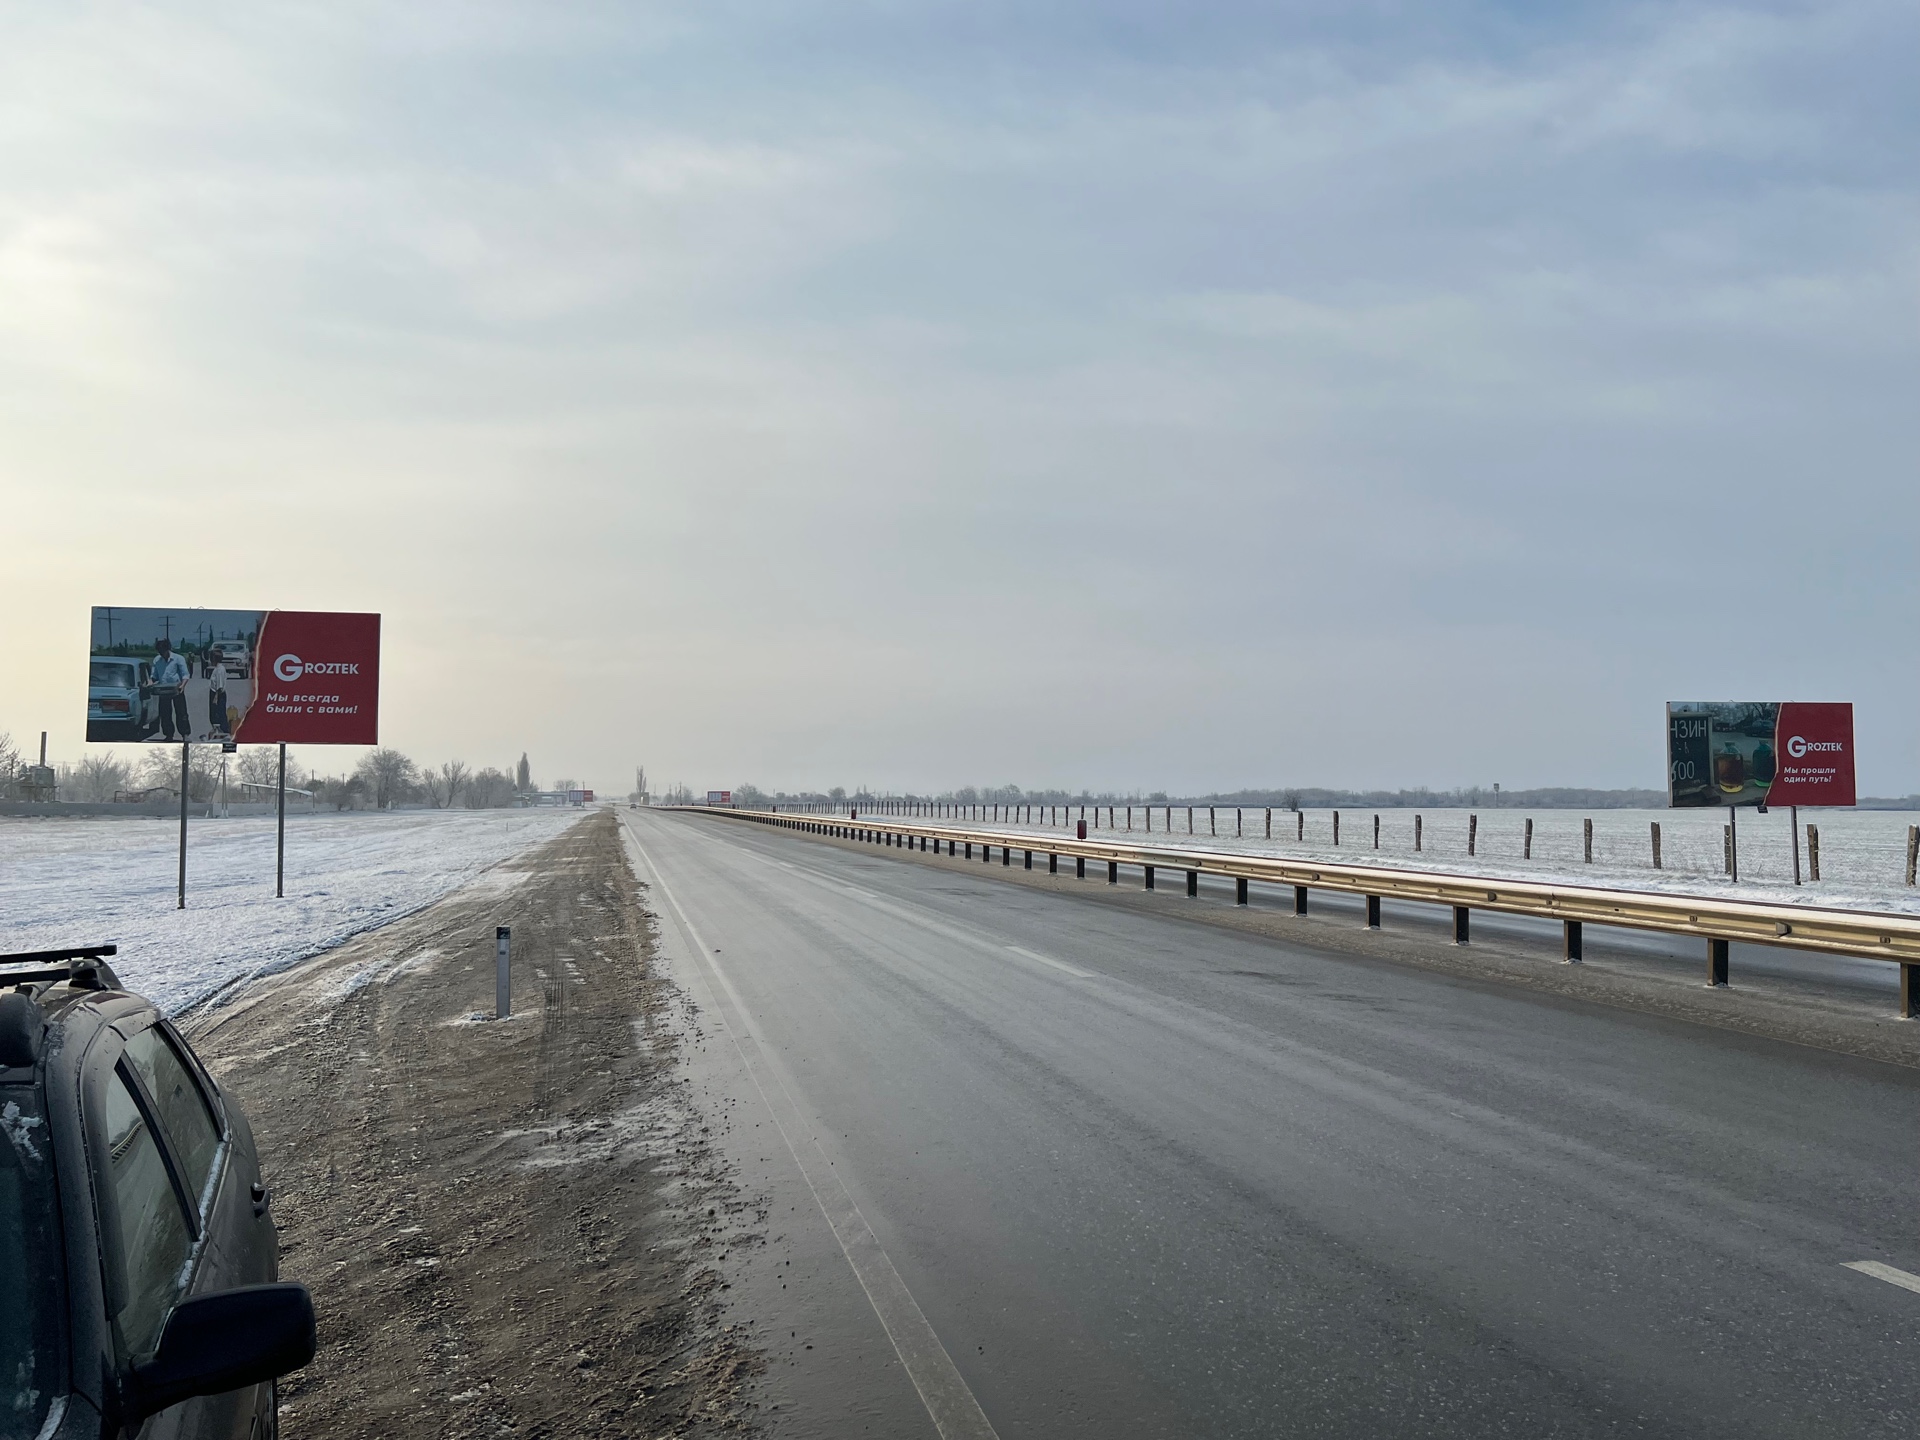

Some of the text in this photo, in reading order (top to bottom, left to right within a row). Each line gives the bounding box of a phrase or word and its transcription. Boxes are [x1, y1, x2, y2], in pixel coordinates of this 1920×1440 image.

[273, 653, 359, 681] GROZTEK
[266, 693, 339, 703] Мы всегда
[266, 704, 302, 713] были
[318, 705, 358, 713] вами!
[1787, 735, 1843, 758] GROZTEK
[1783, 766, 1798, 774] Мы
[1808, 775, 1832, 784] путь!
